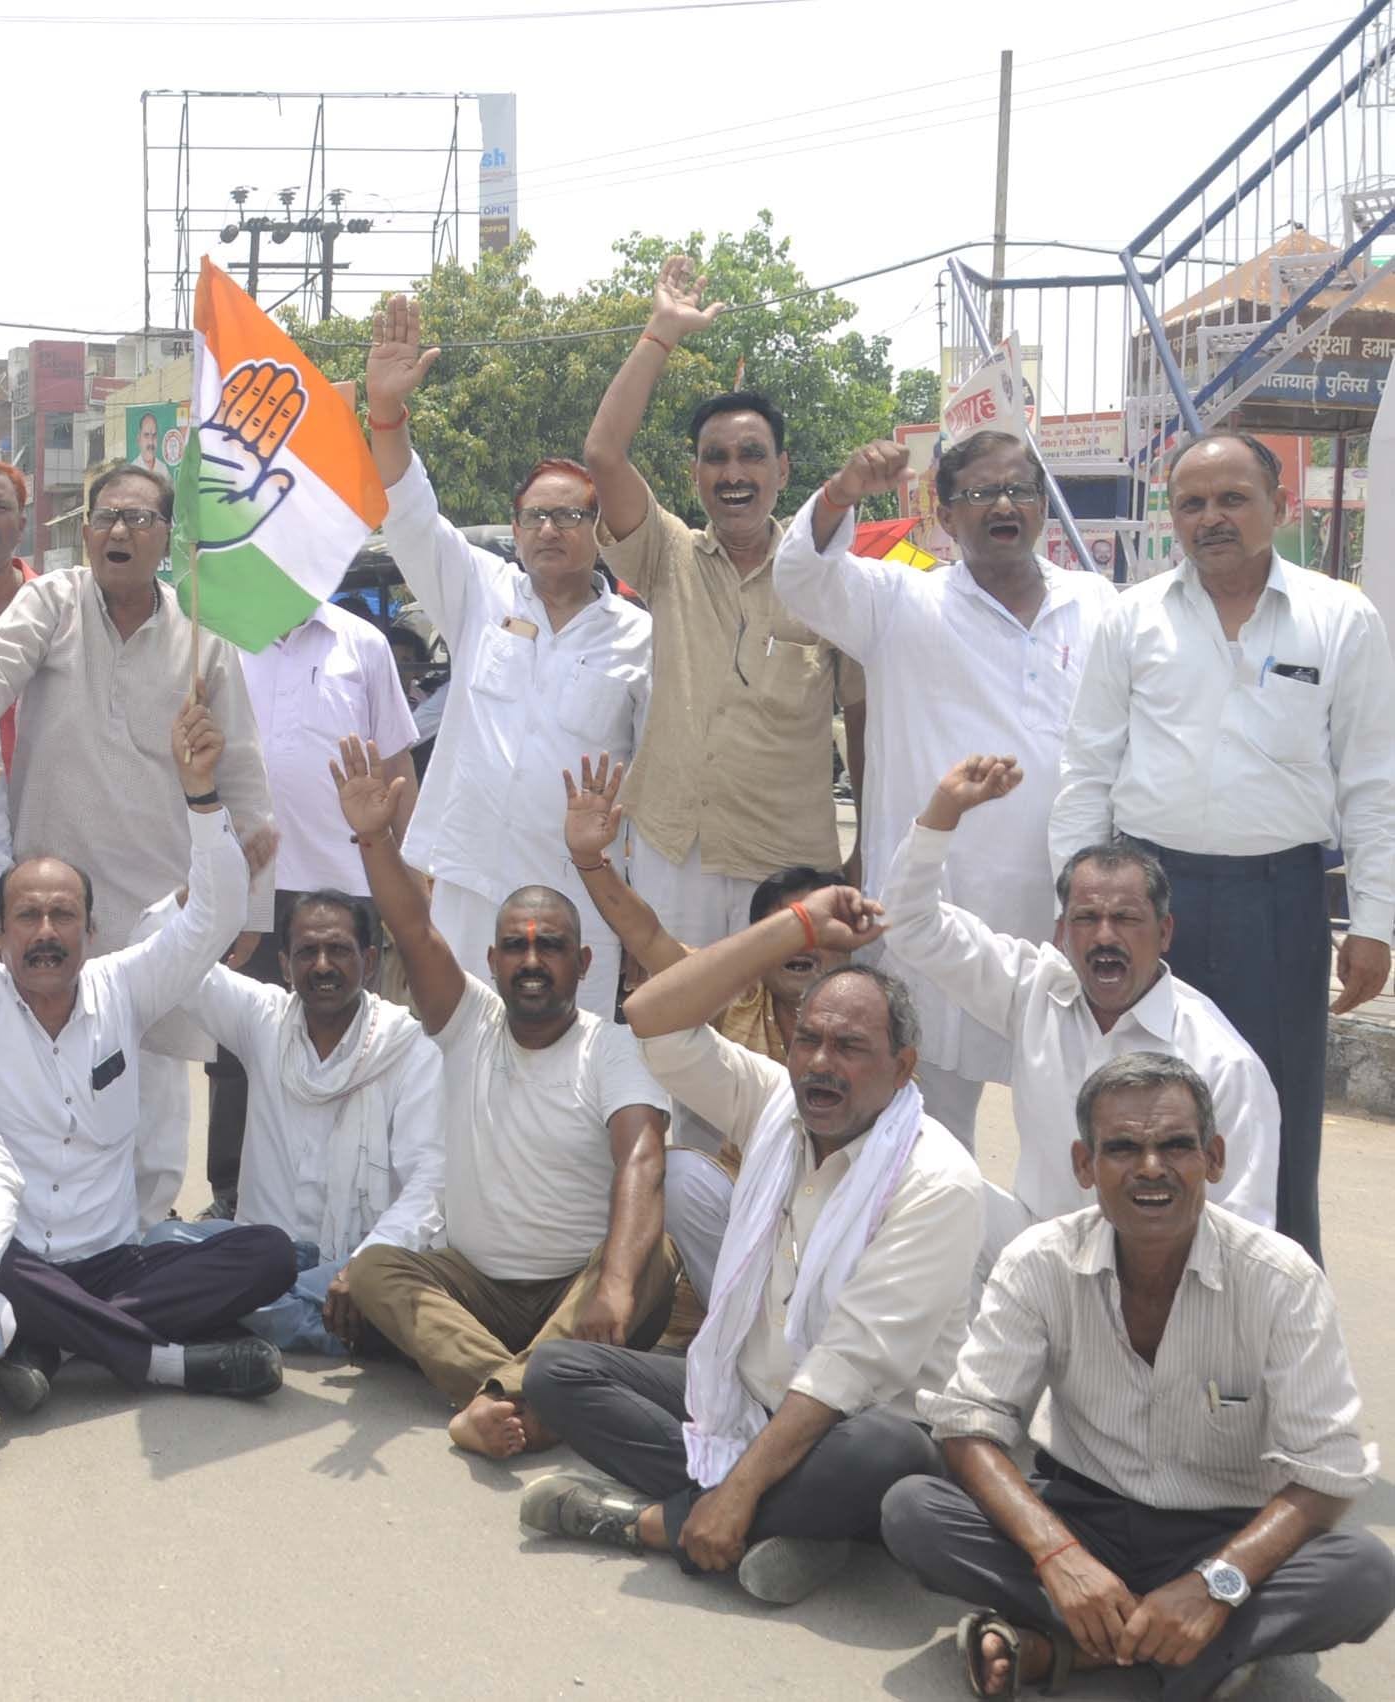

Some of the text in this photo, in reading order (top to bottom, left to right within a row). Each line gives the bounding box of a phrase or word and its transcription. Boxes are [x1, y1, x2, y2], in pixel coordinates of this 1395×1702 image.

[483, 205, 510, 216] OPEN
[1261, 373, 1318, 391] ातायात
[1325, 371, 1369, 397] पुलिस
